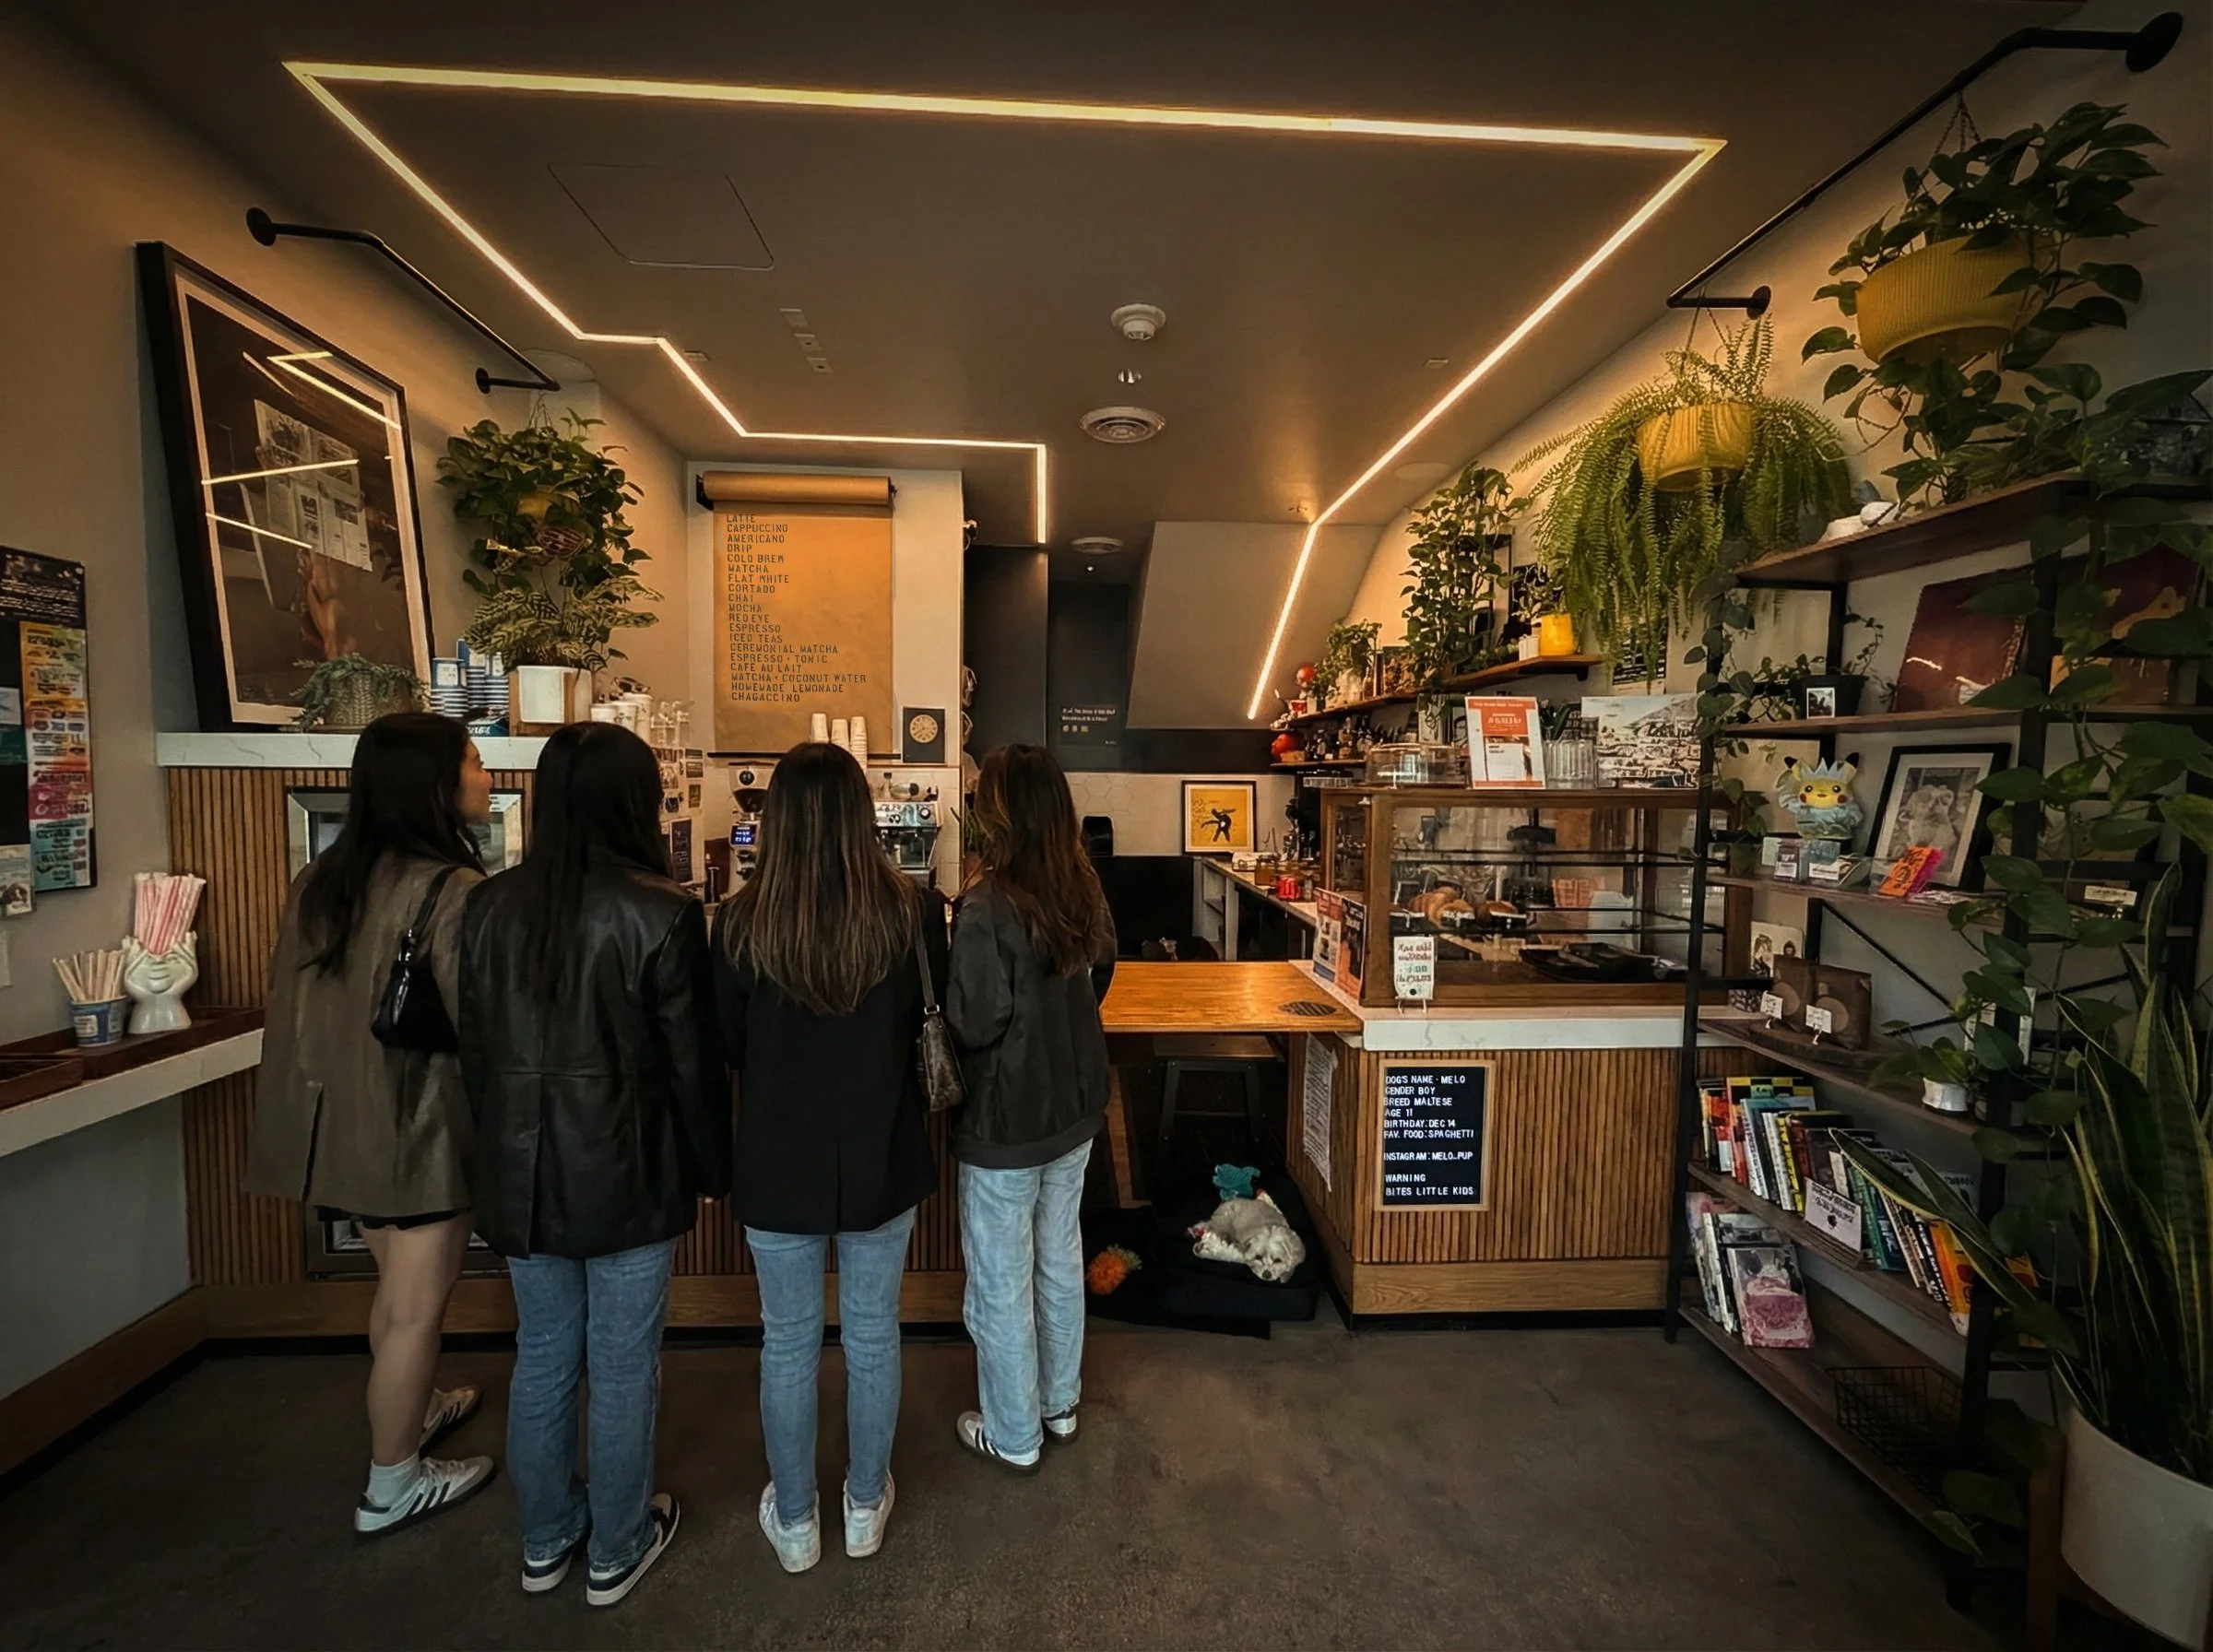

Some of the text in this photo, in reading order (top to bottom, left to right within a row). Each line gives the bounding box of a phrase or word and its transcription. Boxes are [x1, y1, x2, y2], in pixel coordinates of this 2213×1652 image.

[727, 514, 755, 523] LATTE
[727, 524, 788, 533] CAPPUCCINO
[727, 535, 785, 543] AMERICANO
[727, 544, 752, 552] DRIP
[727, 554, 784, 563] COLD BREW
[728, 564, 769, 572] MATCHA
[728, 573, 789, 583] FLAT WHITE
[728, 584, 775, 594] CORTADO
[728, 594, 753, 603] CHAI
[728, 604, 763, 613] MOCHA
[729, 613, 770, 623] RED EYE
[729, 623, 781, 632] ESPRESSO
[729, 633, 783, 643] ICED TEAS
[730, 643, 838, 654] CEREMONIAL MATCHA
[730, 653, 828, 664] ESPRESSO TONIC
[761, 664, 774, 672] AU
[777, 664, 802, 673] LAIT
[731, 673, 867, 683] MATCHA COCONUT WATER
[731, 683, 845, 693] HOMEMADE LEMONADE
[731, 692, 800, 702] CHAGACCINO
[1385, 1075, 1408, 1084] DOG'S
[1411, 1075, 1434, 1084] NAME
[1440, 1075, 1466, 1084] MELO
[1385, 1086, 1436, 1095] GENDER BOY
[1383, 1097, 1453, 1106] BREED MALTESE
[1384, 1108, 1413, 1117] AGE 11
[1428, 1119, 1446, 1127] DEC
[1448, 1119, 1456, 1127] 14
[1383, 1130, 1401, 1139] FAV.
[1428, 1129, 1474, 1139] SPAGHETTI
[1431, 1151, 1473, 1161] MELO_PUP
[1385, 1174, 1426, 1183] WARNING
[1385, 1186, 1474, 1196] BITES LITTLE KIDS
